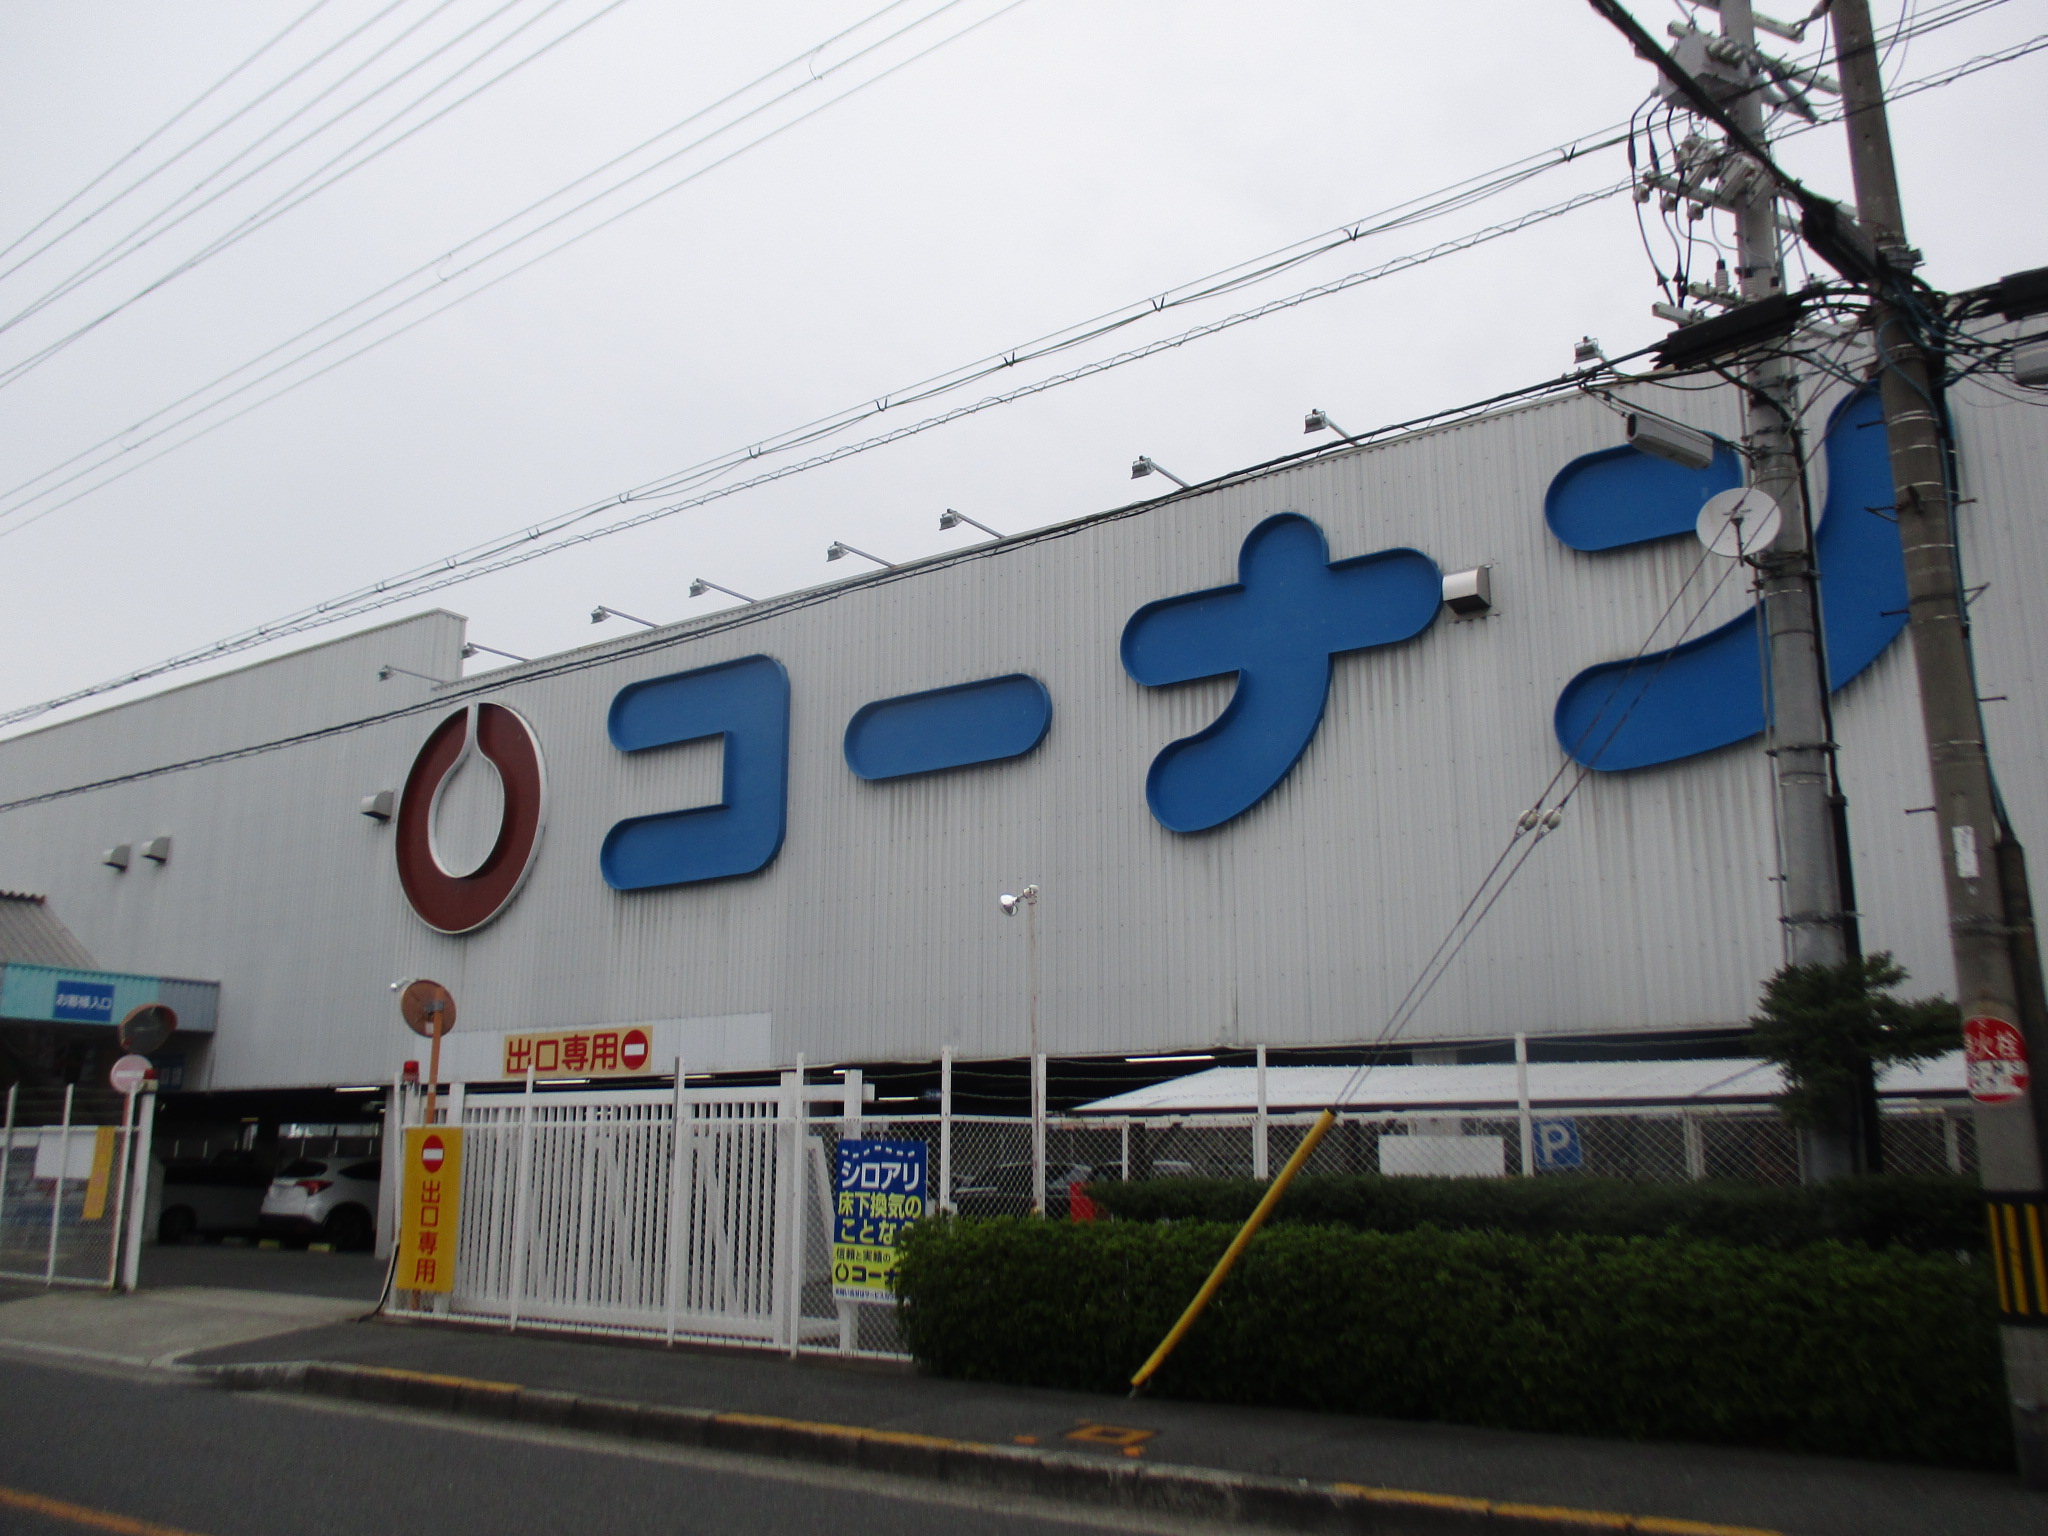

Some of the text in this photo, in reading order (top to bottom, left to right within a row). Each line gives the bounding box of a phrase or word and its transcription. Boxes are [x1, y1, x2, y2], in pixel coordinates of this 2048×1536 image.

[600, 379, 1957, 893] コーナン
[506, 1032, 618, 1074] 出口専用
[1540, 1123, 1570, 1163] P
[841, 1161, 920, 1191] シロアリ
[837, 1192, 922, 1219] 床下換気の
[414, 1180, 441, 1284] 出口専用
